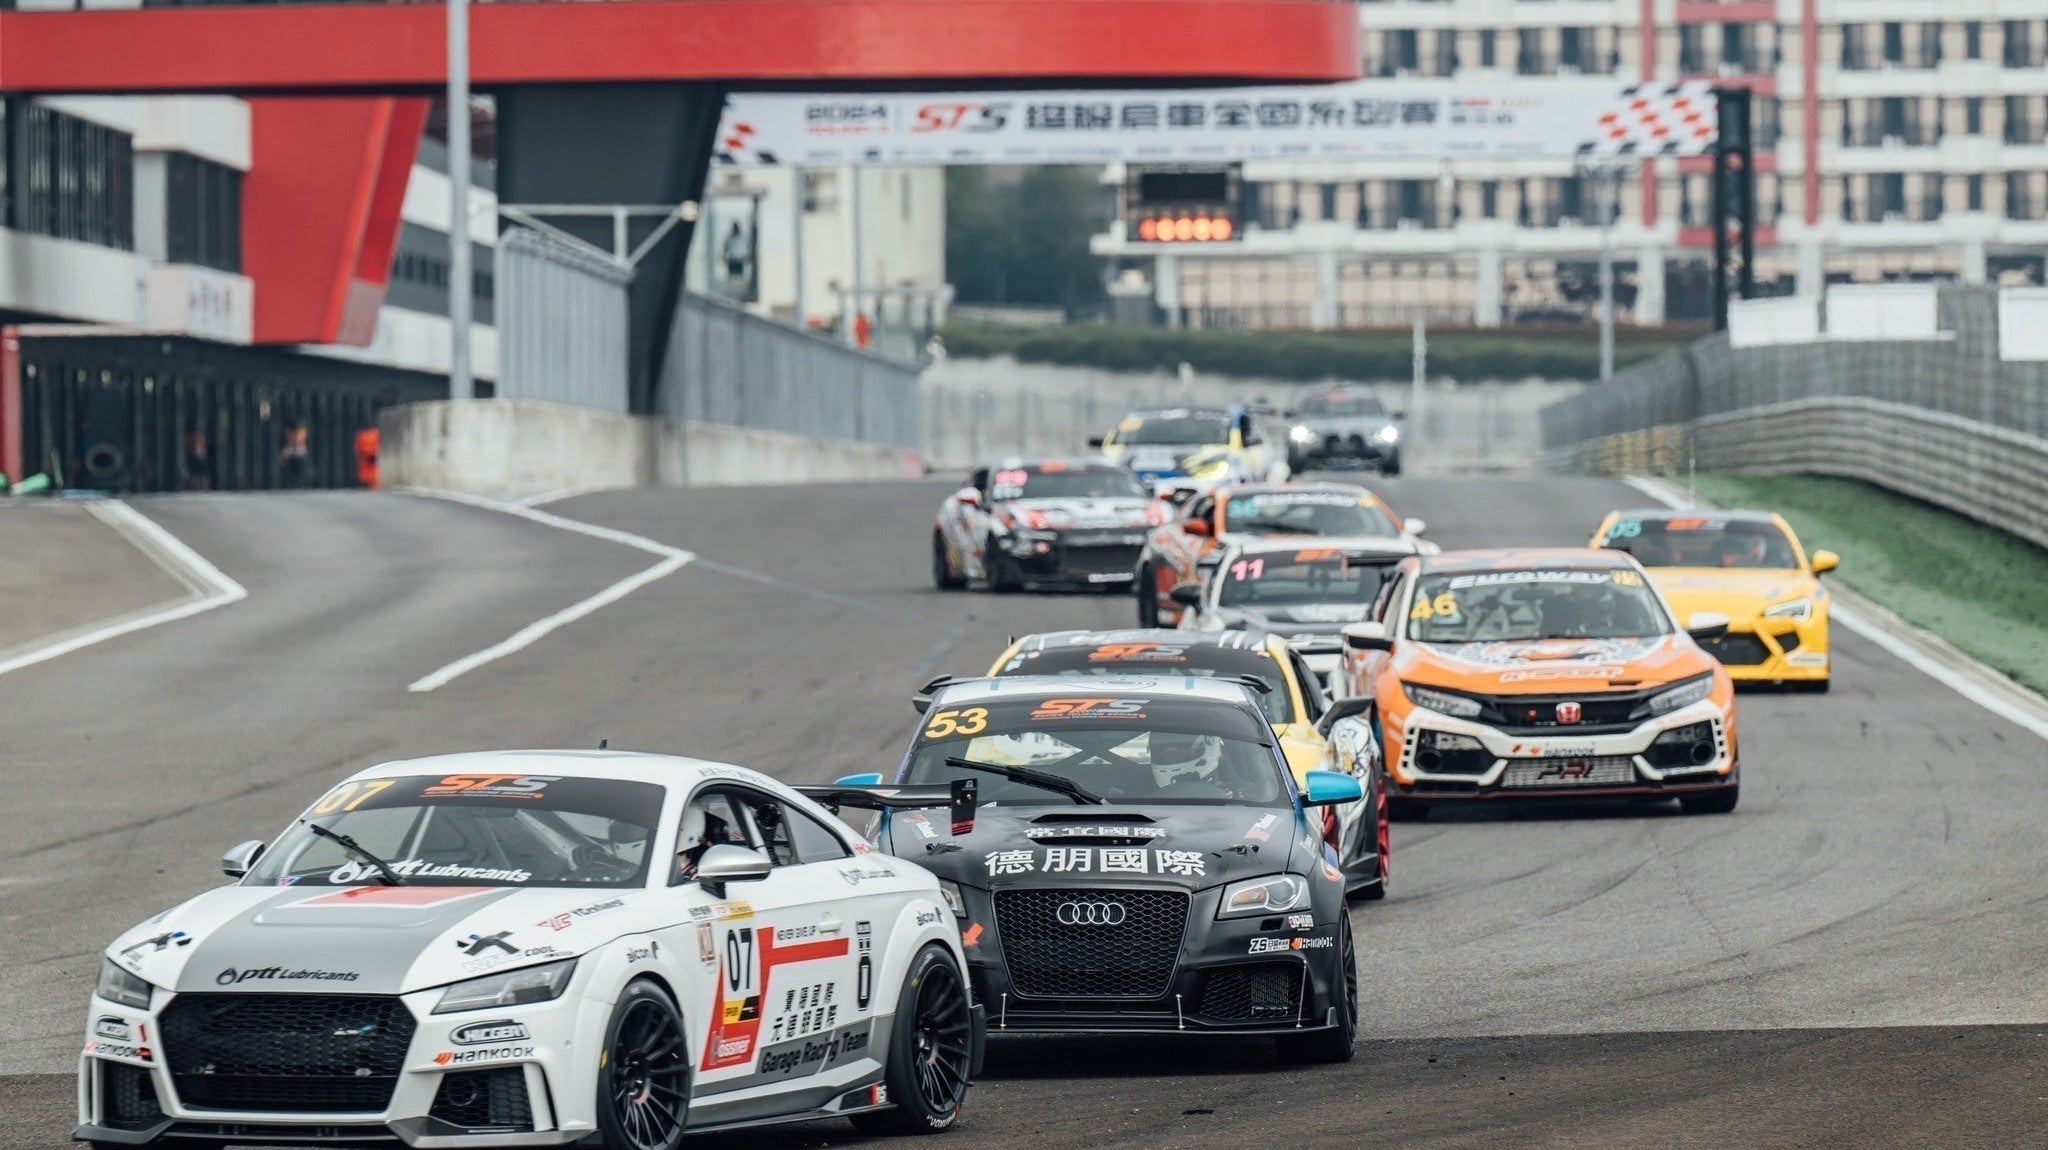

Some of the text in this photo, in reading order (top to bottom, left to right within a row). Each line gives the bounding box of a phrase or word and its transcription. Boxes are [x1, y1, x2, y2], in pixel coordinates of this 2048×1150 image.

[804, 103, 888, 122] 2024
[909, 103, 1014, 134] STS
[1231, 558, 1265, 581] 11
[1411, 592, 1458, 620] 46
[1088, 643, 1189, 659] STS
[1030, 698, 1151, 716] STS
[924, 707, 989, 739] 53
[423, 773, 561, 792] STS
[313, 780, 396, 815] 07
[414, 862, 533, 883] Lubricants
[984, 847, 1206, 877] 德朋國際
[1249, 937, 1268, 953] ZS
[726, 927, 752, 992] 07
[236, 966, 361, 984] ptt Lubricants
[762, 1030, 870, 1074] Garage Racing Team
